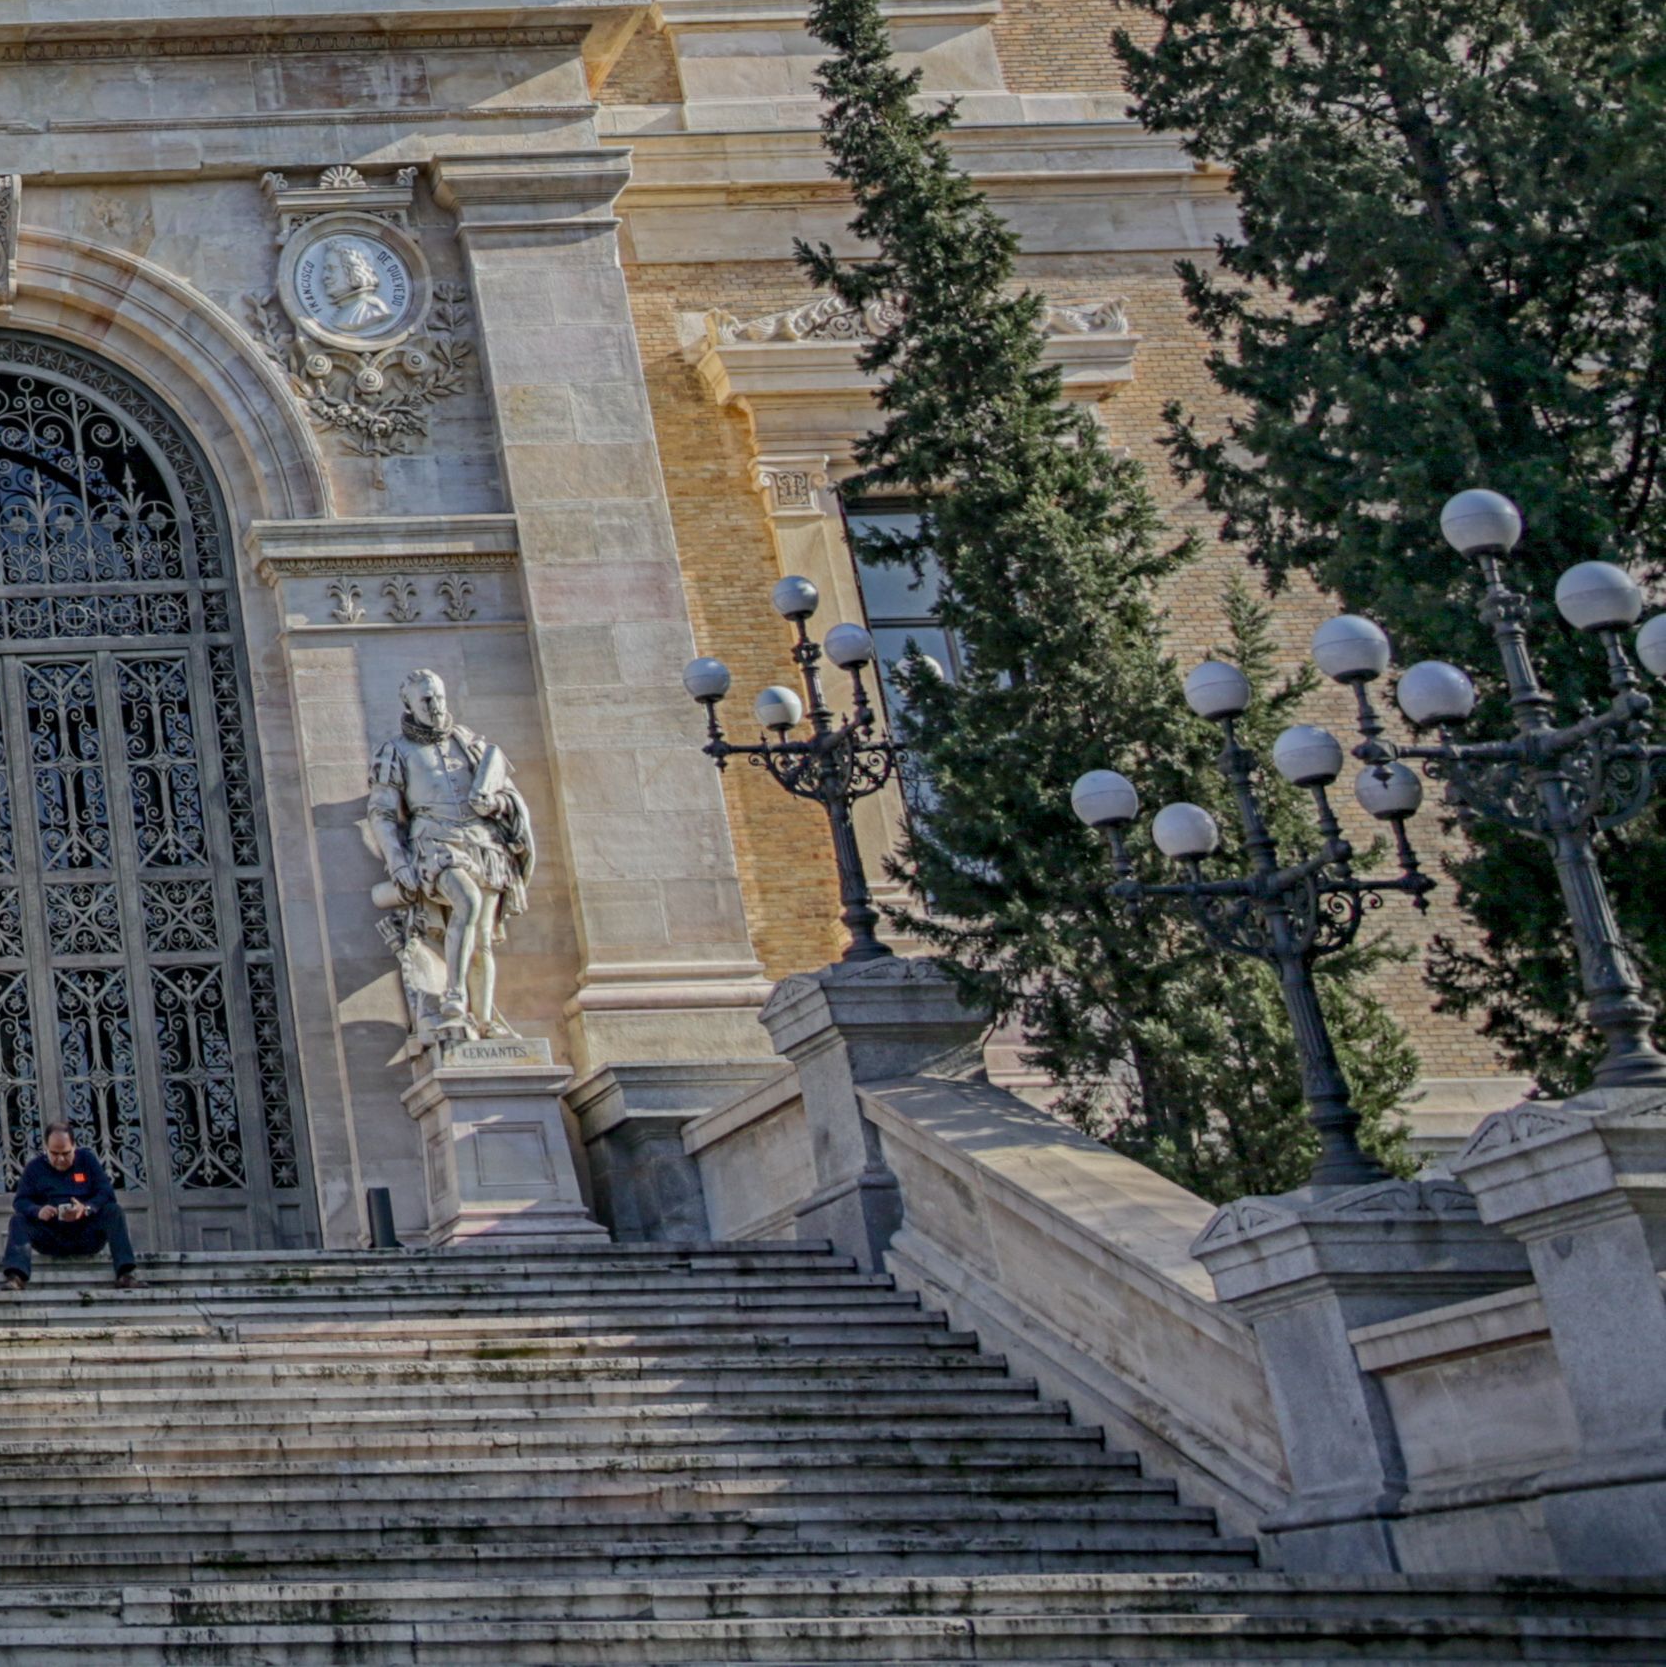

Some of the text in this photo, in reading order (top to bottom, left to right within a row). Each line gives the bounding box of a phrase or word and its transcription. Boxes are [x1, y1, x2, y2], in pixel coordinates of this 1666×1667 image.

[303, 250, 406, 314] FRANCISCO DE QUEVEDO
